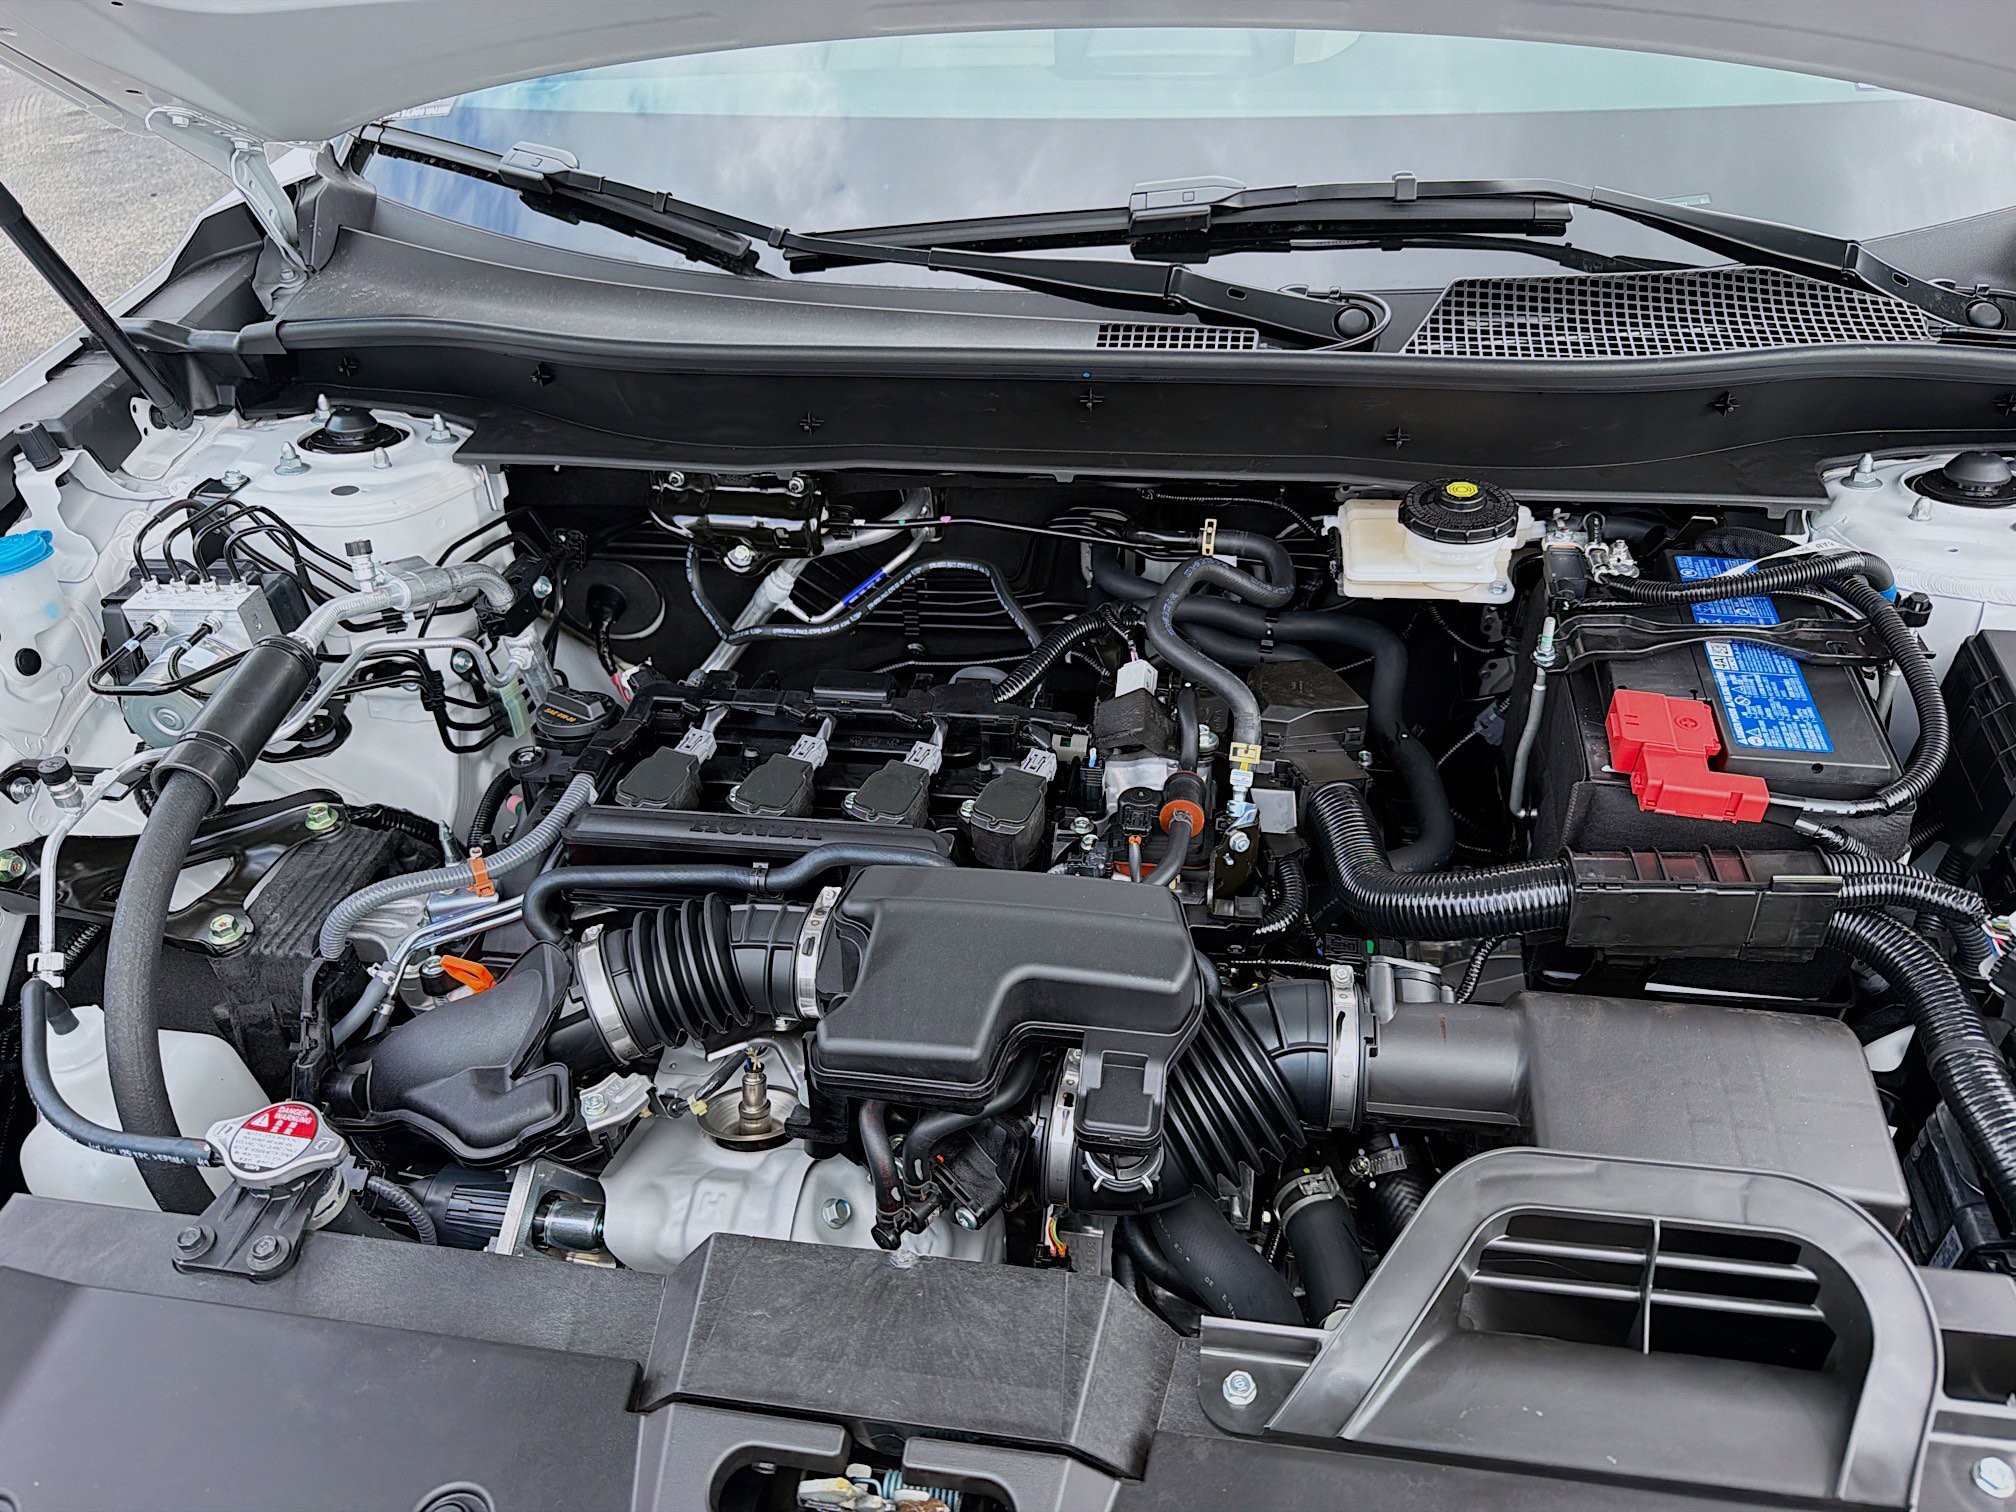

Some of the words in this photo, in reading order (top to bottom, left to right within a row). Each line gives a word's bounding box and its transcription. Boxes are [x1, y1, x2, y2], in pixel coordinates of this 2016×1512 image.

[690, 818, 822, 841] HONDA
[273, 1111, 313, 1125] WARNUNG
[277, 1105, 310, 1117] DANGER
